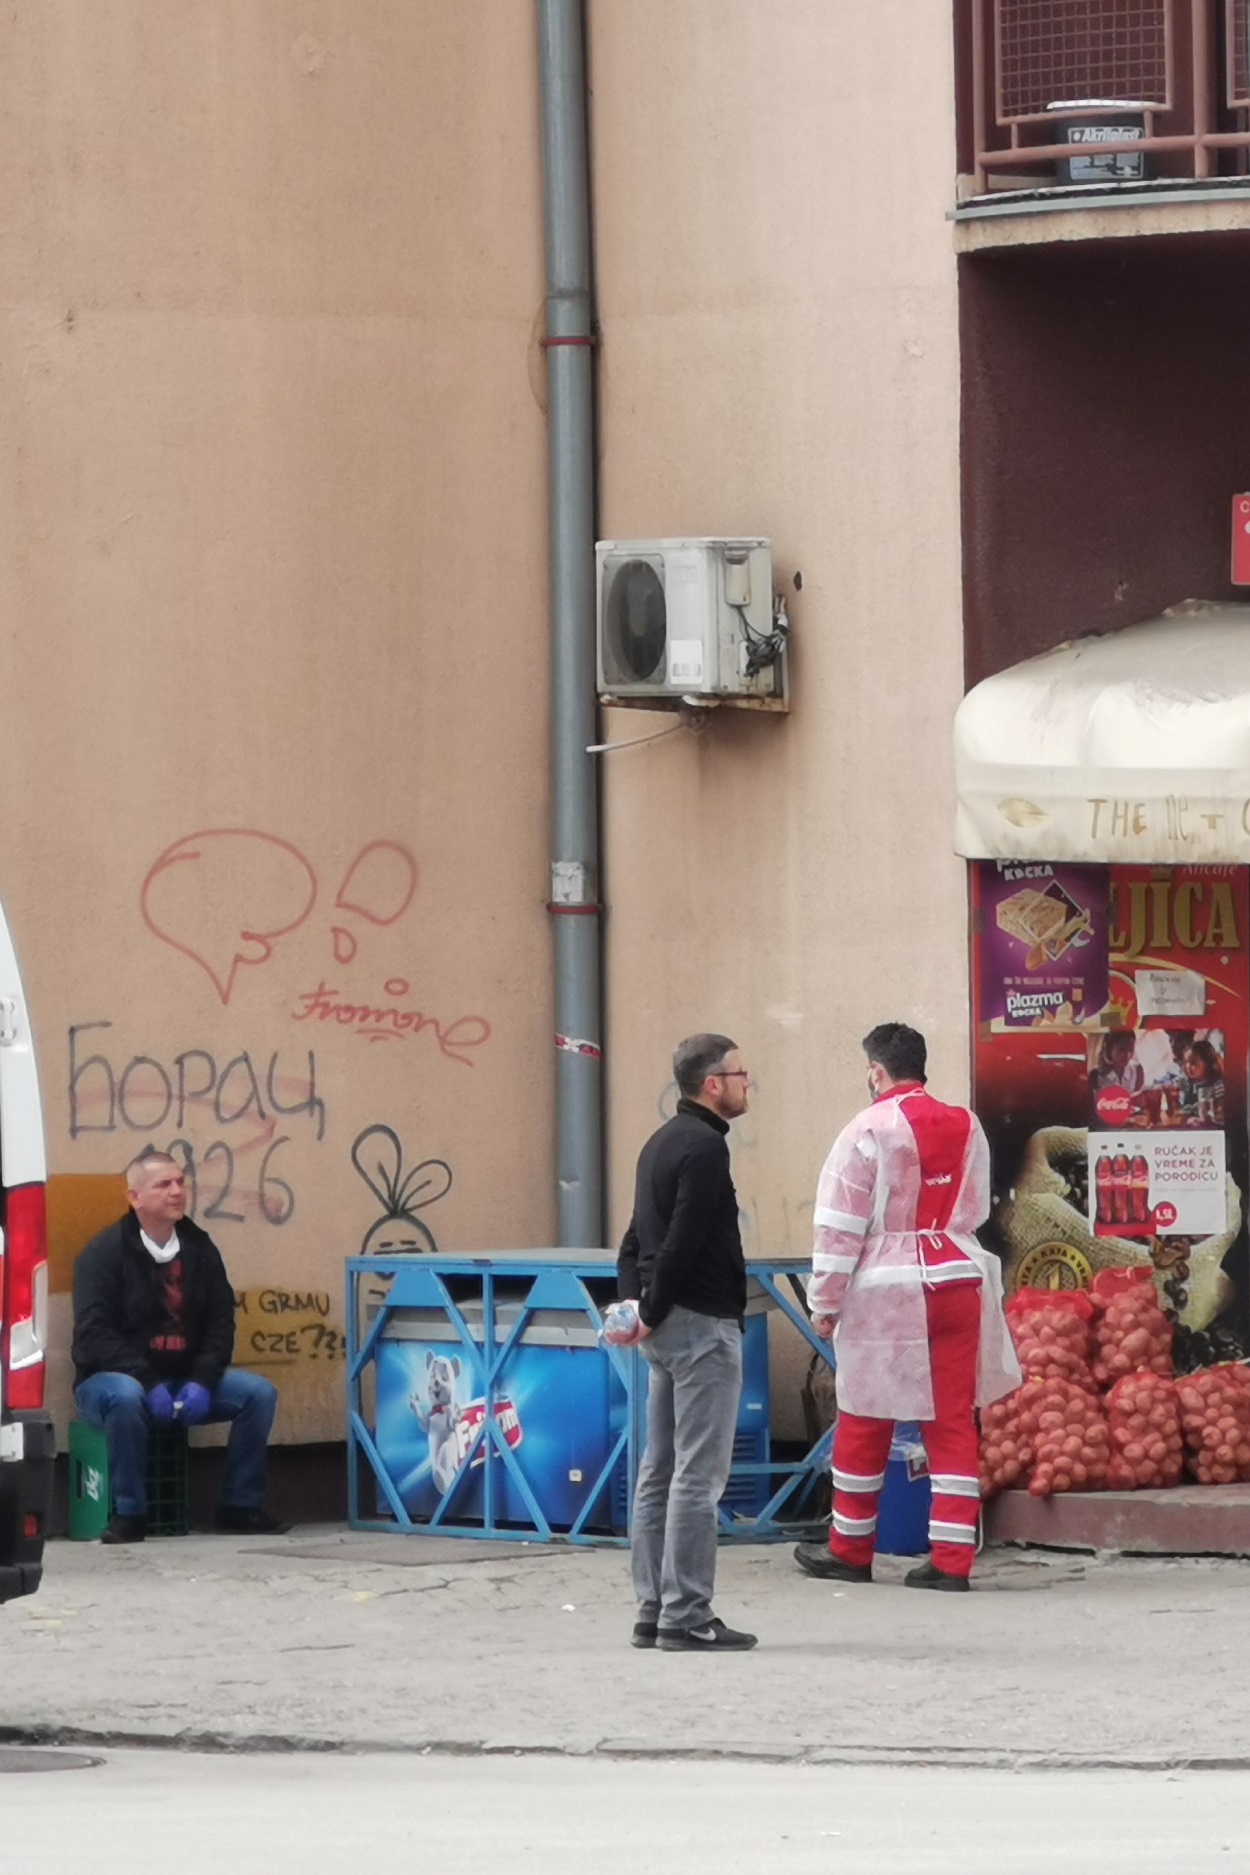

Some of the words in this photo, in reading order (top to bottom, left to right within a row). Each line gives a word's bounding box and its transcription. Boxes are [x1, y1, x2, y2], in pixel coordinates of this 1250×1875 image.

[1087, 797, 1148, 840] THE
[1006, 992, 1064, 1013] plazma
[1154, 1145, 1197, 1157] RUČAK
[1199, 1146, 1213, 1156] JE
[1154, 1159, 1195, 1169] VREME
[1199, 1159, 1216, 1169] ZA
[124, 1135, 295, 1227] 926
